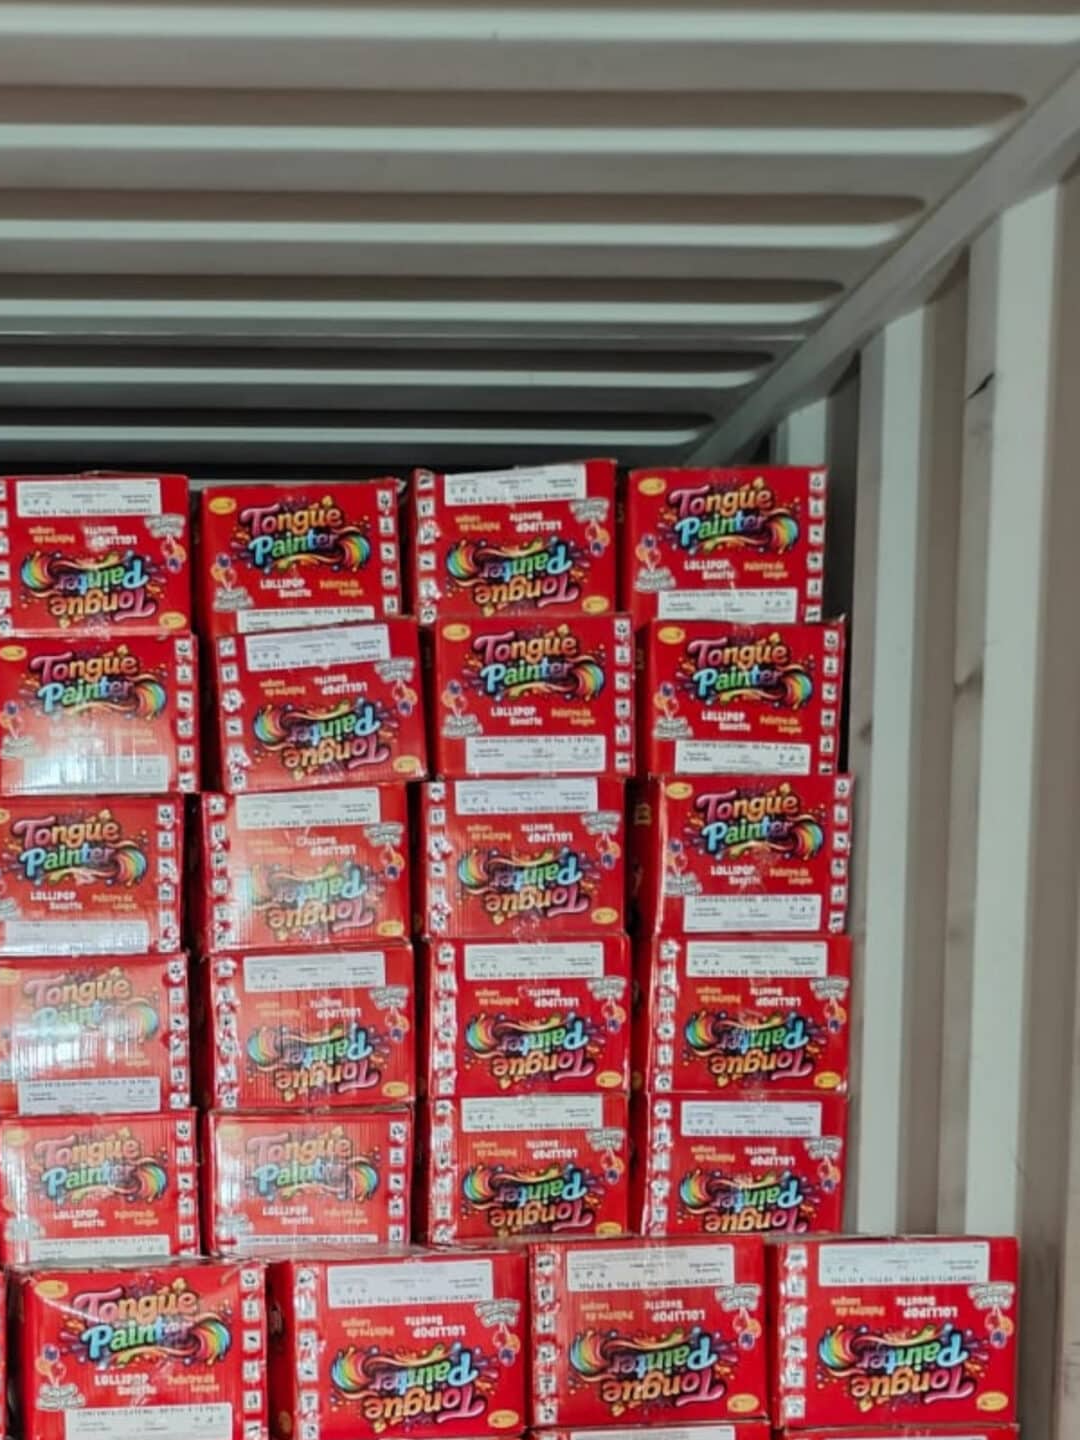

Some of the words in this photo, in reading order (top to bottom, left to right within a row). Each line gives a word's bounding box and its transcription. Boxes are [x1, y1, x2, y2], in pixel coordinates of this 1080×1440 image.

[669, 483, 772, 518] Tongue
[240, 503, 342, 536] Tongue
[675, 510, 768, 548] Painter
[249, 529, 339, 566] Painter
[478, 543, 572, 582] Painter
[475, 575, 579, 608] Tongue
[473, 630, 577, 664] Tongue
[688, 636, 787, 671] Tongue
[481, 657, 574, 694] Painter
[693, 664, 783, 699] Painter
[488, 854, 582, 892] Painter
[485, 884, 589, 918] Tongue
[496, 1019, 588, 1056] Painter
[493, 1049, 594, 1082] Tongue
[493, 1170, 586, 1207] Painter
[490, 1199, 593, 1233] Tongue
[901, 1305, 957, 1318] LOLLIPOP
[606, 1334, 716, 1378] Painter
[855, 1331, 967, 1374] Painter
[602, 1370, 725, 1407] Tongue
[851, 1366, 975, 1405] Tongue
